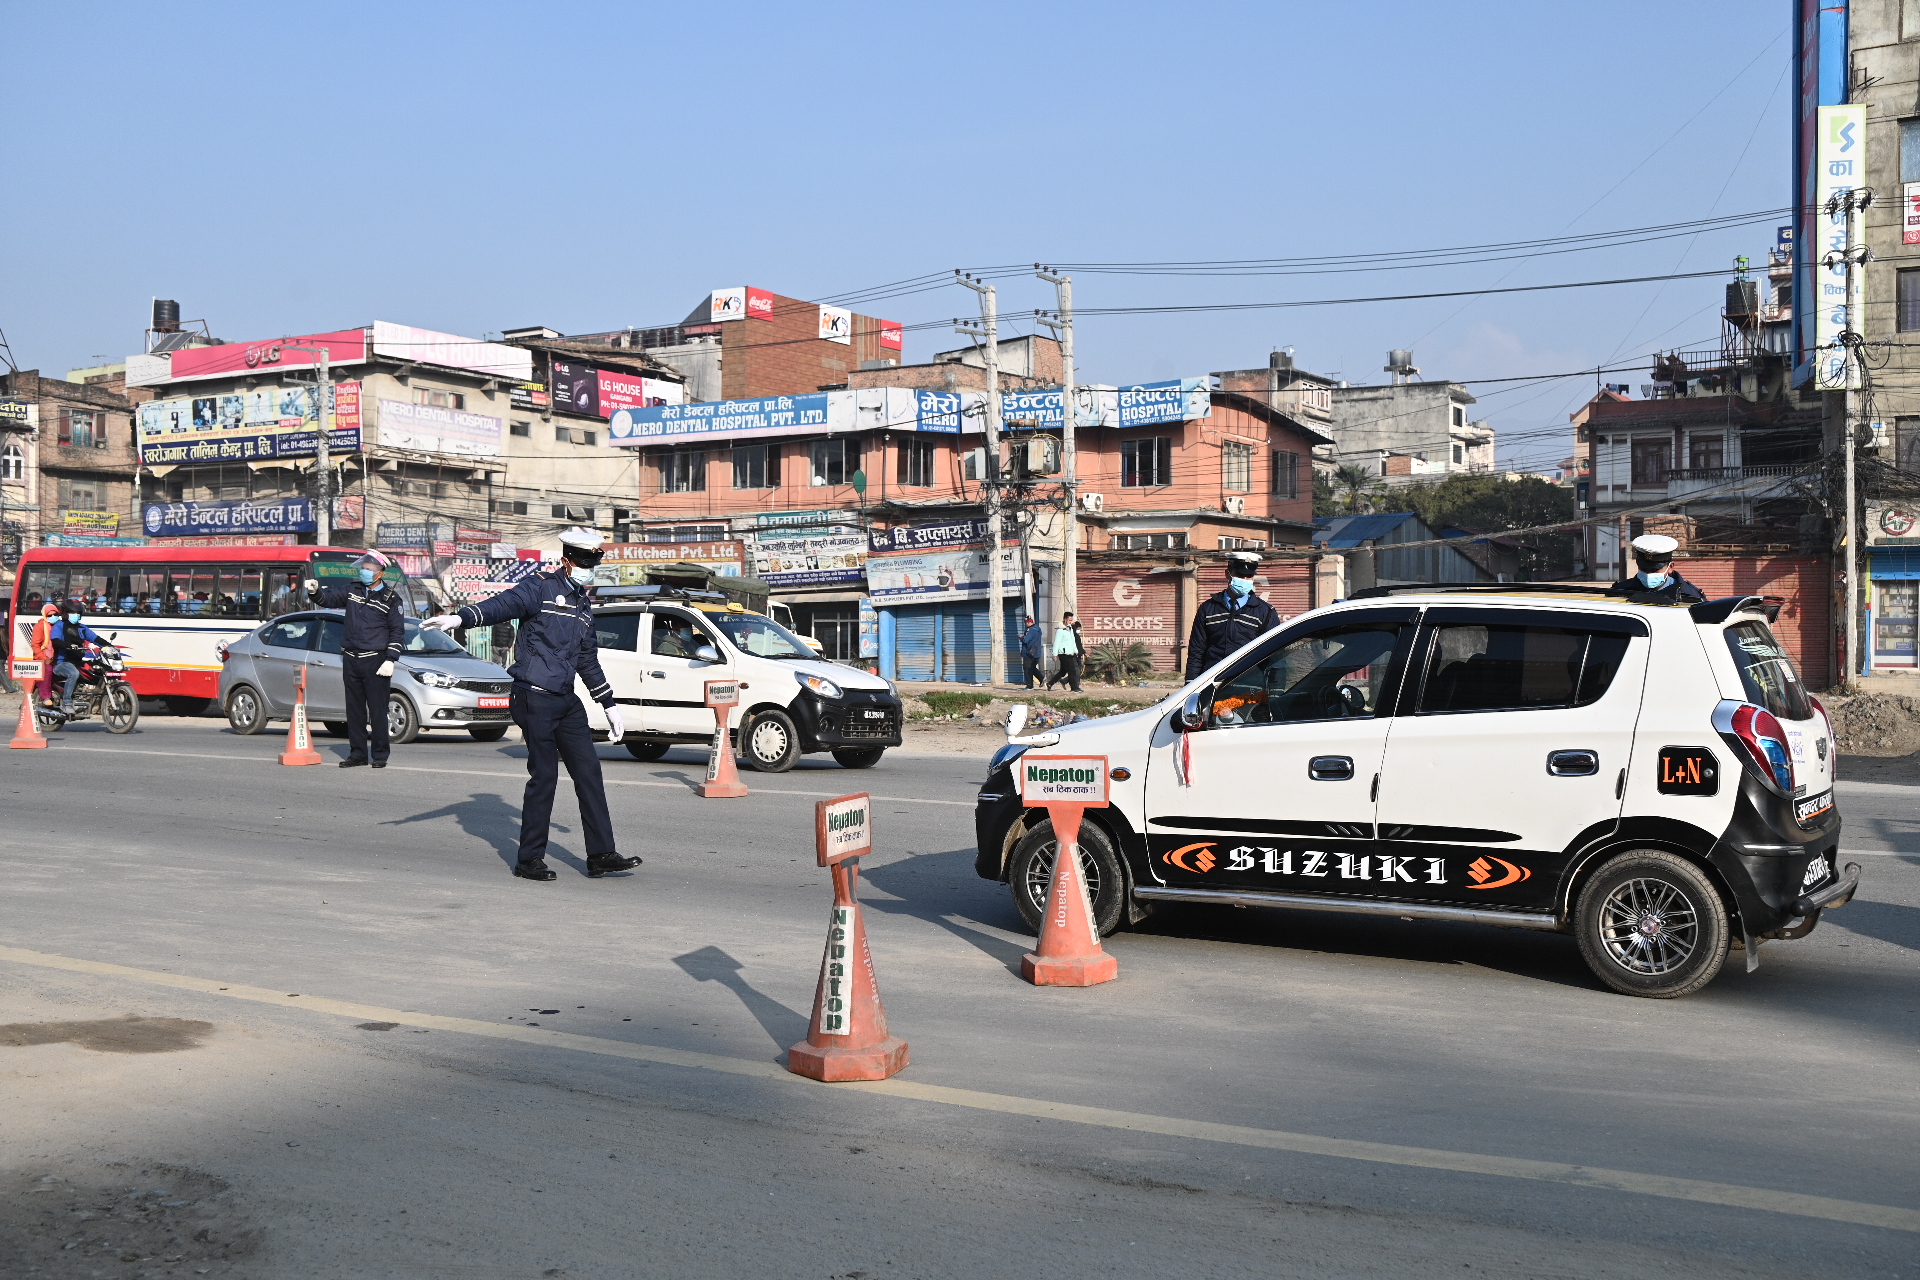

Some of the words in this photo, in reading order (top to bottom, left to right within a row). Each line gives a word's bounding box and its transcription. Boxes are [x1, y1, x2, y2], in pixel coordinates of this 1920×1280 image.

[713, 296, 733, 311] RK
[821, 312, 841, 331] RK
[261, 345, 281, 363] LG
[336, 384, 358, 396] English
[600, 379, 611, 390] LG
[613, 382, 641, 396] HOUSE
[1120, 386, 1181, 407] हस्पिटल
[610, 393, 632, 403] GANGABU
[921, 392, 960, 413] मेरो
[383, 400, 413, 417] MERO
[415, 406, 453, 424] DENTAL
[454, 412, 499, 431] HOSPITAL
[661, 404, 681, 419] मेरो
[684, 403, 714, 417] डेन्टल
[718, 400, 760, 415] हस्पिटल
[1122, 403, 1182, 422] HOSPITAL
[632, 420, 663, 437] MERO
[666, 418, 709, 434] DENTAL
[712, 413, 767, 432] HOSPITAL
[771, 411, 796, 426] PVT.
[801, 408, 827, 424] LTD.
[921, 412, 958, 427] MERO
[258, 435, 273, 456] लि.
[165, 504, 188, 526] मेरो
[190, 503, 229, 525] डेन्टल
[231, 501, 284, 524] हस्पिटल
[384, 528, 405, 537] MERO
[603, 547, 619, 559] est
[623, 546, 677, 559] Kitchen
[680, 545, 706, 558] Pvt.
[711, 544, 739, 557] Ltd.
[893, 558, 923, 567] PLUMBING
[1093, 616, 1163, 630] ESCORTS
[14, 663, 39, 671] Nepatop
[709, 685, 735, 695] Nepatop
[1028, 765, 1095, 784] Nepatop
[828, 808, 865, 833] Nepatop
[1224, 845, 1448, 885] SUZUKI
[1056, 871, 1070, 928] Nepatop
[827, 909, 847, 1031] Nepatop
[862, 936, 880, 1003] Nepatop
